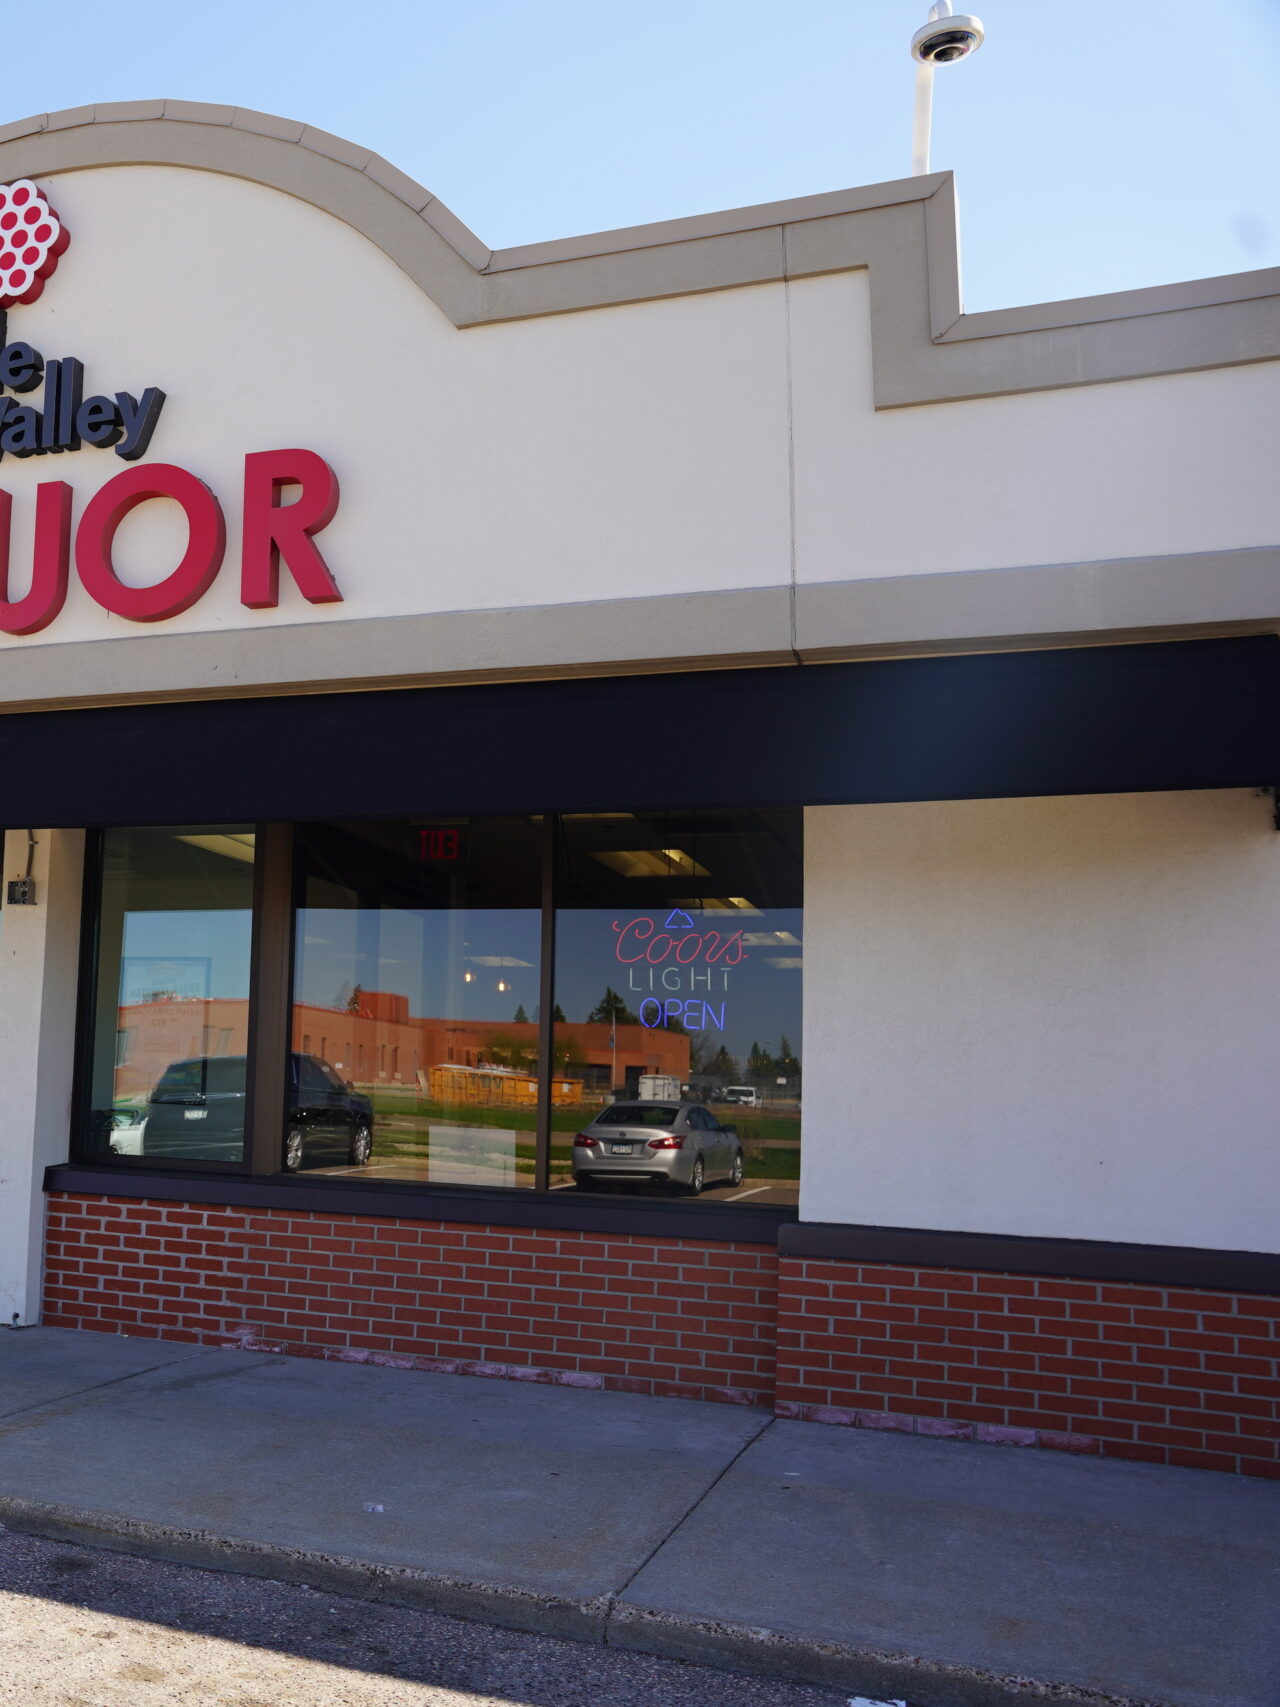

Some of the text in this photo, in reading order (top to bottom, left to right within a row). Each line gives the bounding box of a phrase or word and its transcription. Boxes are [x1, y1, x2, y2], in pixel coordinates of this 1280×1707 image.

[612, 917, 750, 965] Coors
[629, 967, 733, 991] LIGHT
[639, 997, 726, 1032] OPEN
